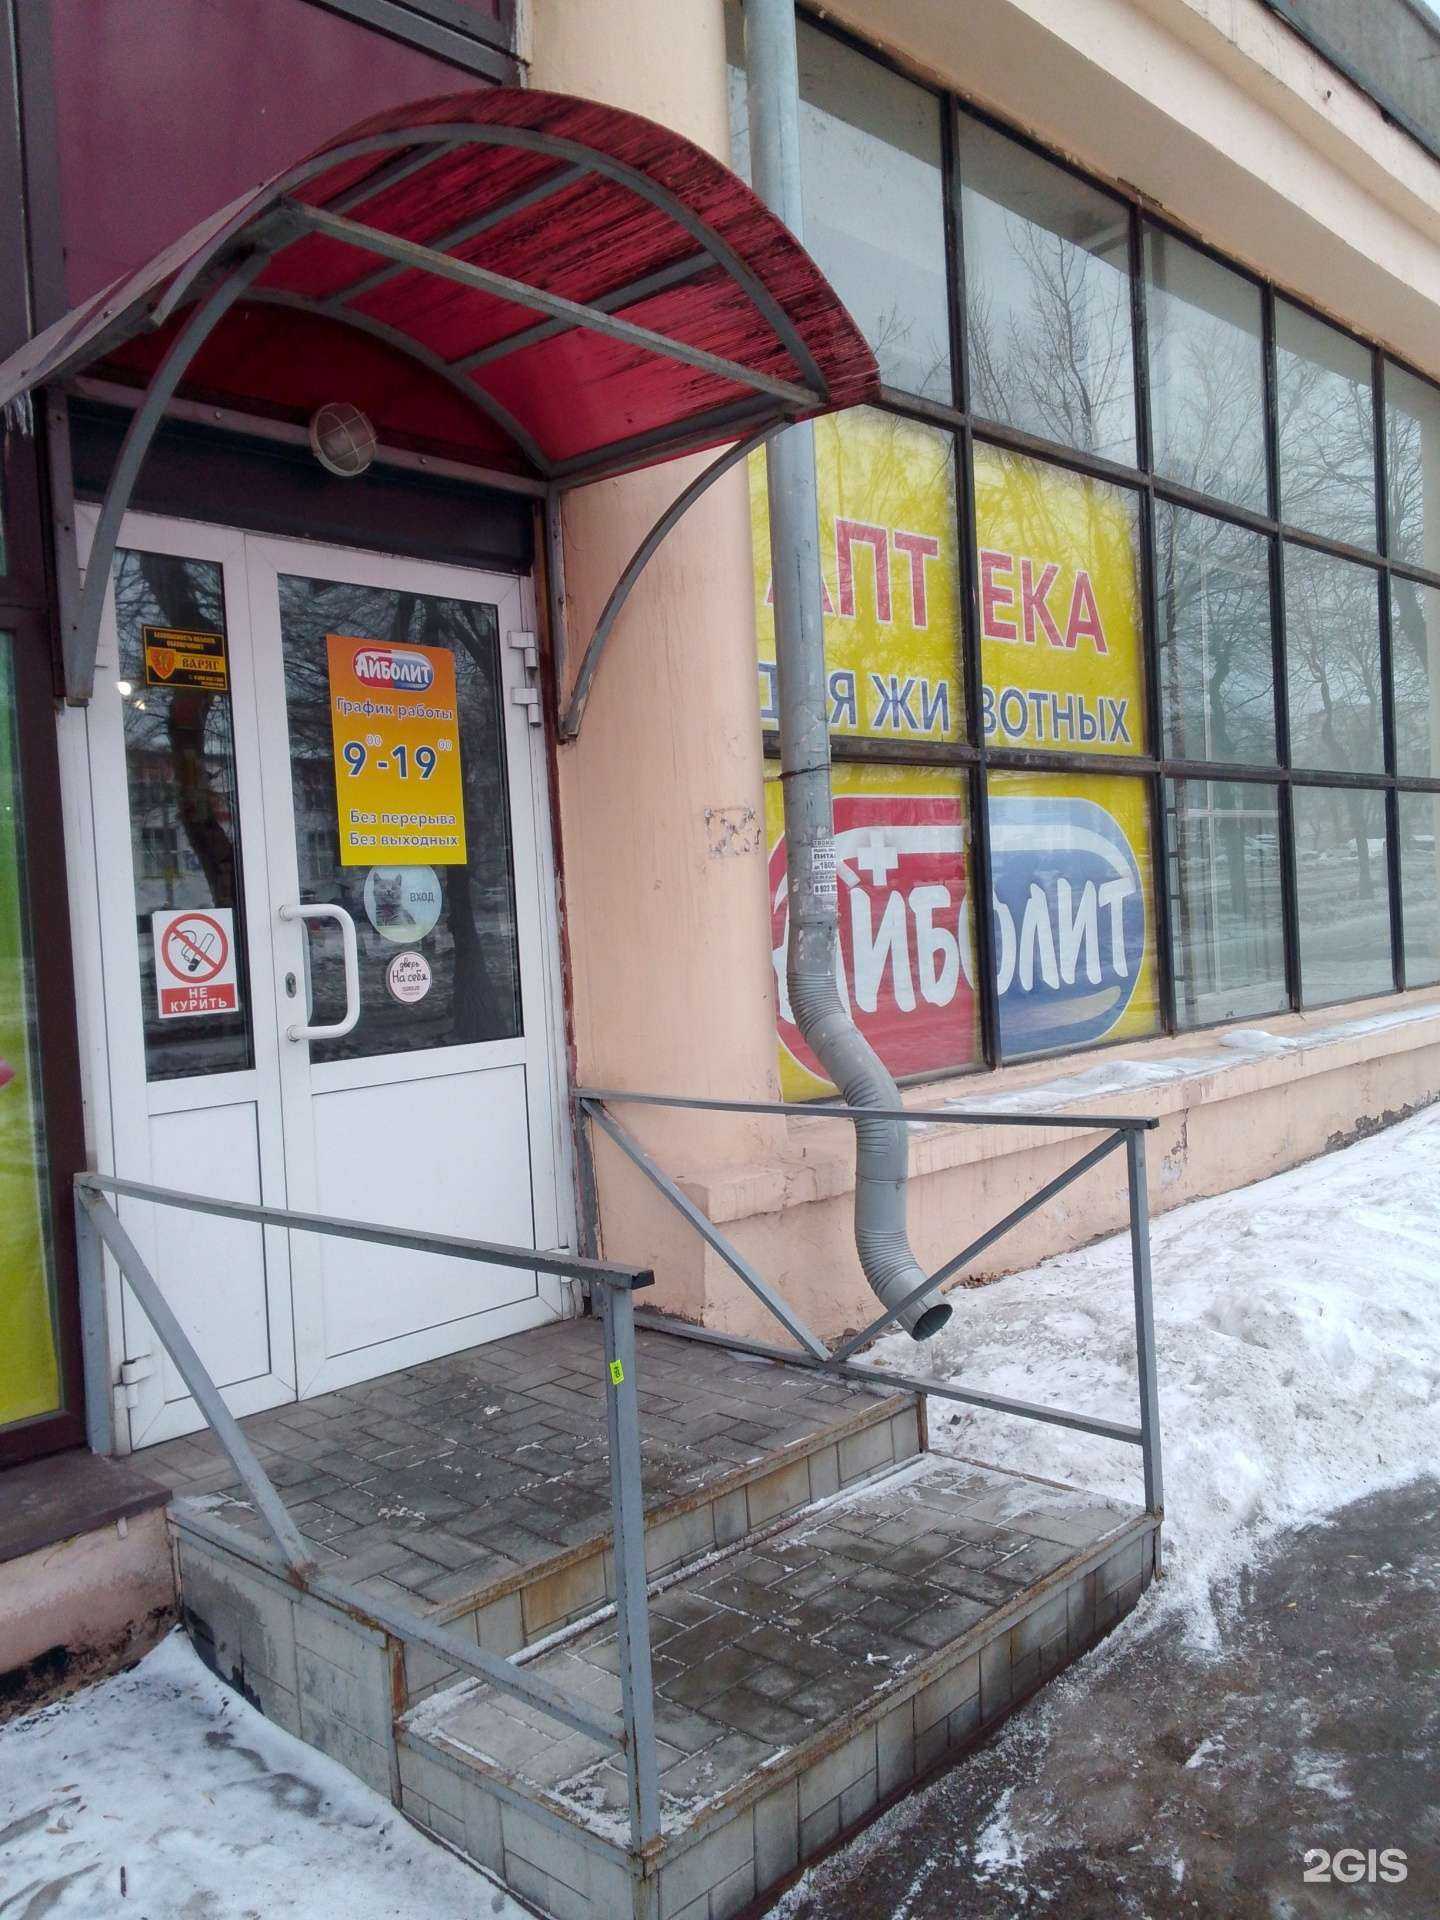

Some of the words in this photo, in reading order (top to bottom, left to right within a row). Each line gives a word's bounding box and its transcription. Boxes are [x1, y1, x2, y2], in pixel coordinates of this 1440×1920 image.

[336, 697, 393, 717] График
[398, 703, 453, 720] работы
[349, 808, 377, 824] Без
[381, 813, 456, 829] перерыва
[349, 832, 377, 846] Без
[381, 834, 458, 848] выходных
[409, 891, 435, 904] ВХОД
[392, 969, 406, 983] На
[188, 987, 208, 999] НЕ
[170, 997, 228, 1012] КУРИТЬ
